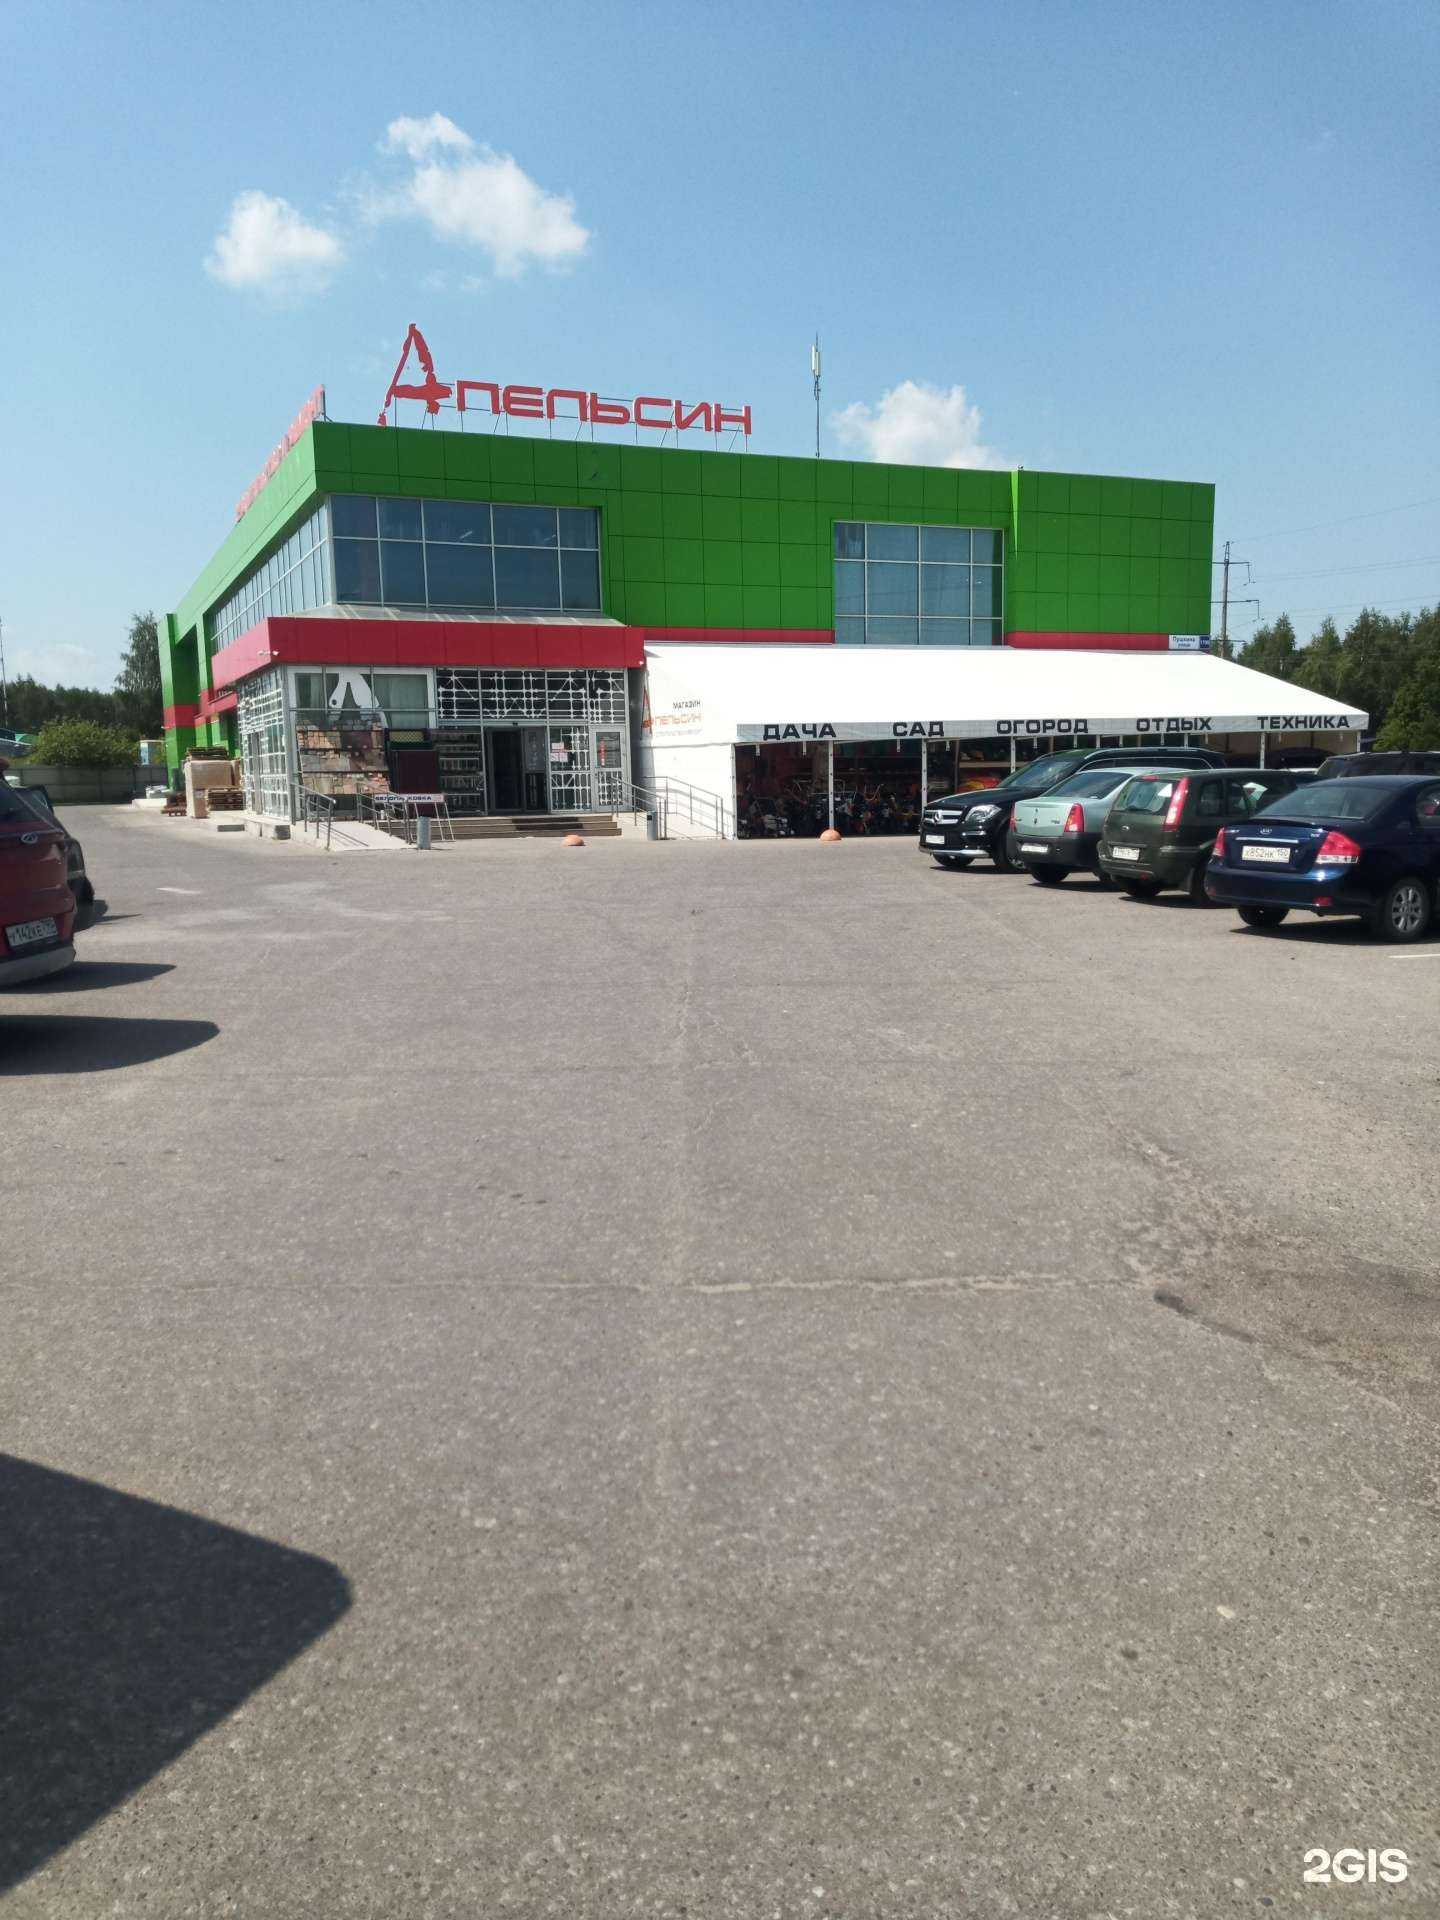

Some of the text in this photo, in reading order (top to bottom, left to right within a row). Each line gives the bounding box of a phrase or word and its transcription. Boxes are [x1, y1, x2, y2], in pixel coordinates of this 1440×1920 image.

[672, 700, 701, 710] МАГАЗИН
[763, 714, 1351, 741] ДАЧА САД ОГОРОД ОТДЫХ ТЕХНИКА
